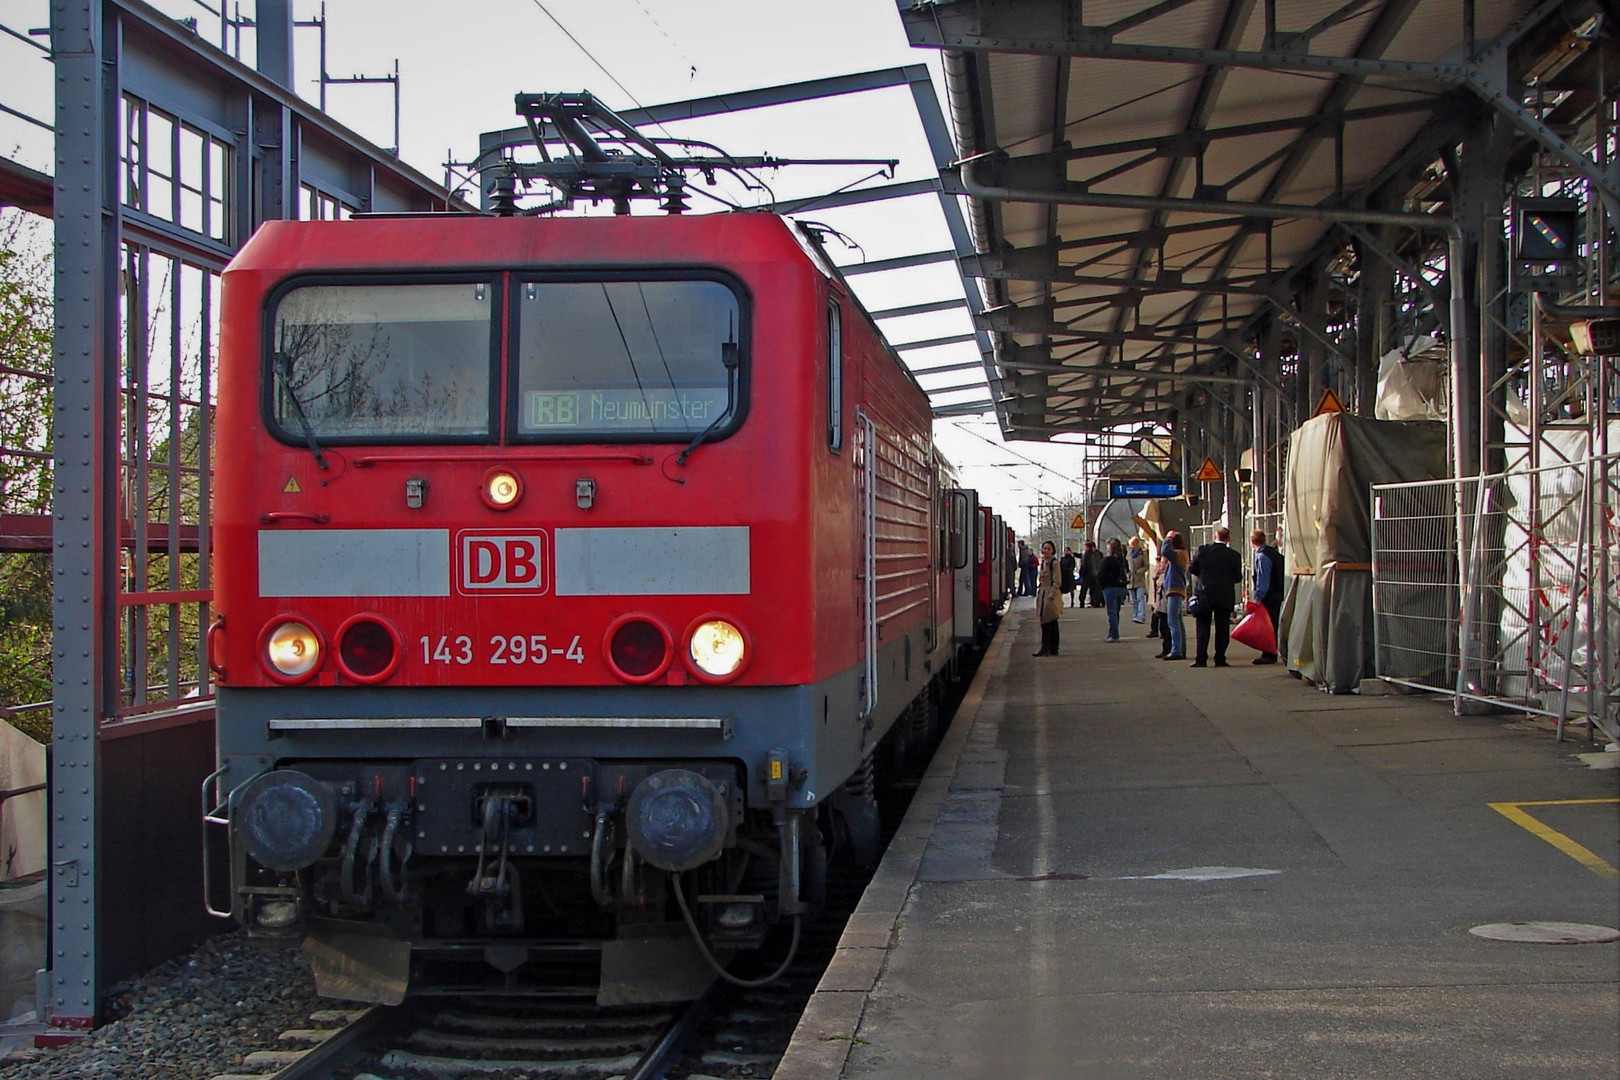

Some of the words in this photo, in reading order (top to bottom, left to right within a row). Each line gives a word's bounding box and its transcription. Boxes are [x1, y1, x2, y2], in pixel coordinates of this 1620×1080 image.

[537, 396, 574, 423] RB
[1118, 484, 1123, 493] 1
[468, 540, 537, 584] DB
[419, 635, 473, 665] 143
[489, 635, 585, 665] 295-4
